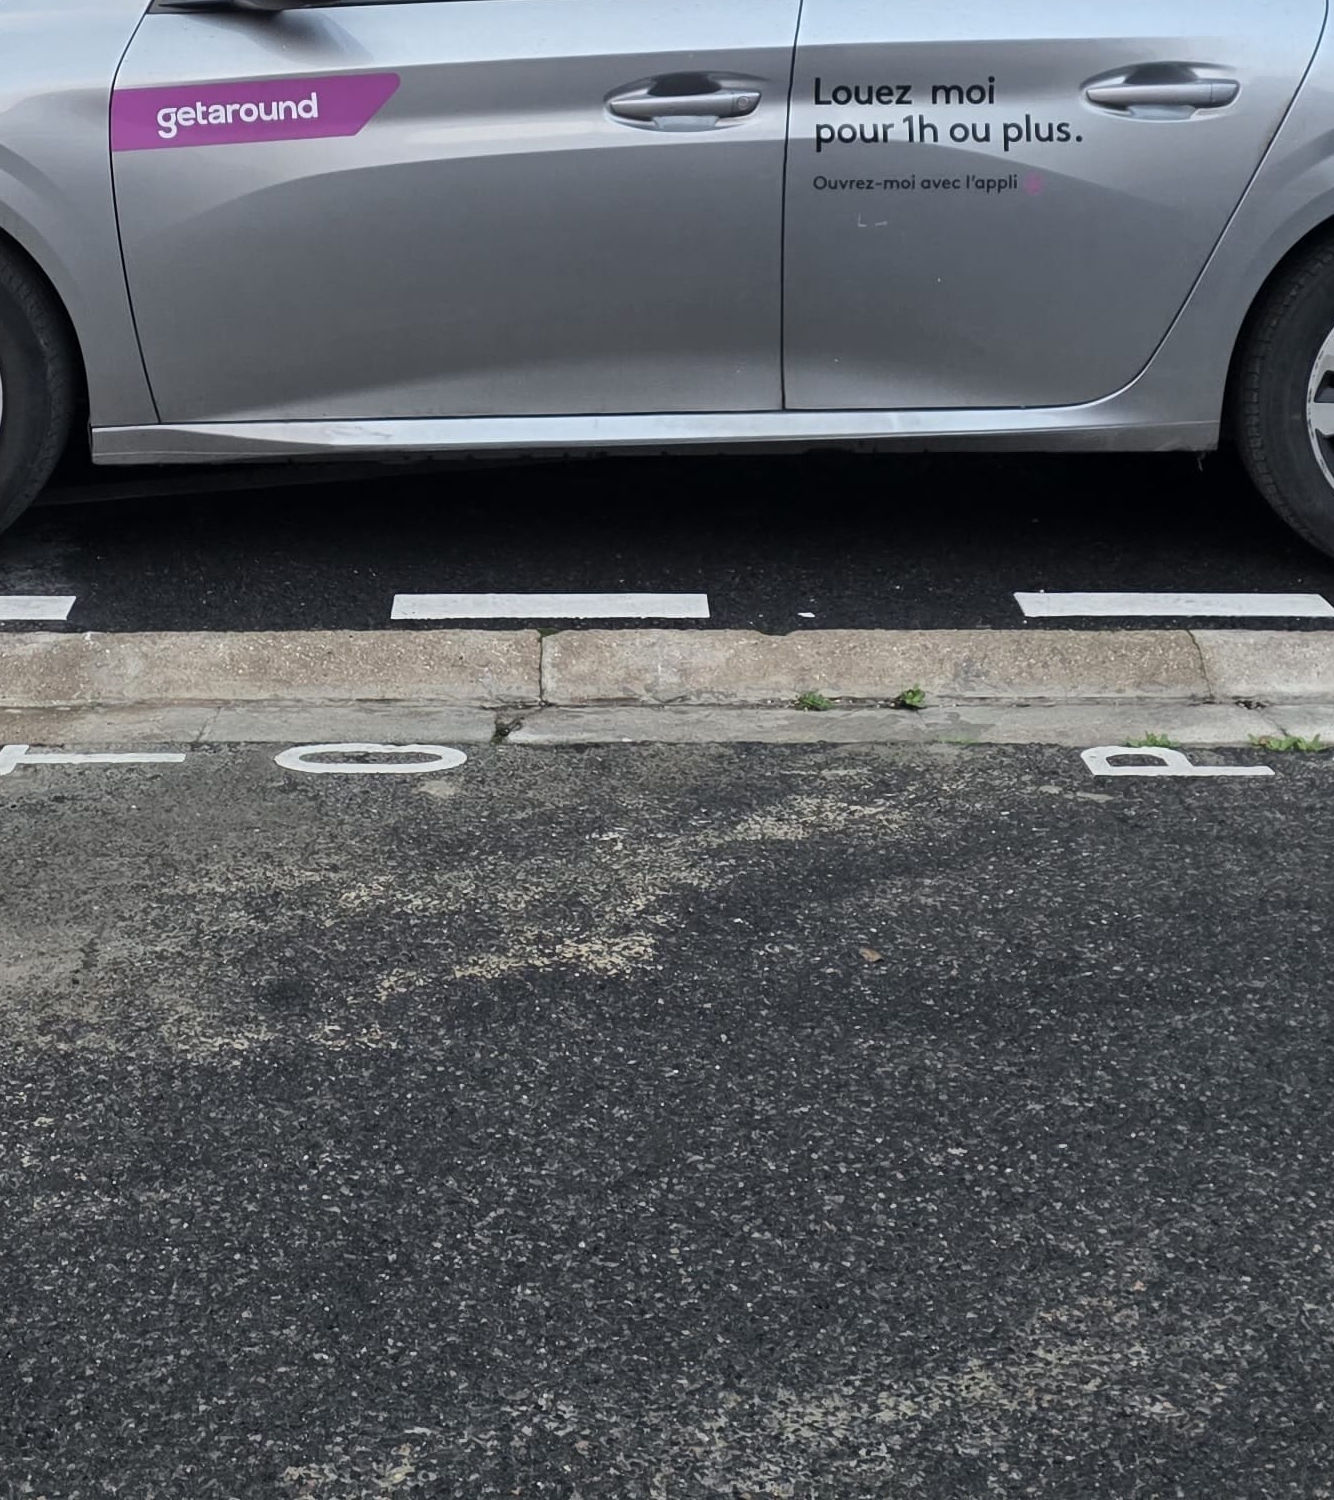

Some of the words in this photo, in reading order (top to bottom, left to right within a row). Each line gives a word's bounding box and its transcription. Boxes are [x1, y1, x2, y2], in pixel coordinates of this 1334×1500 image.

[813, 77, 912, 105] Louez
[931, 76, 995, 105] moi
[156, 92, 319, 138] getaround
[815, 122, 895, 152] pour
[902, 114, 939, 143] 1h
[948, 122, 991, 143] ou
[1003, 114, 1083, 152] plus.
[813, 174, 916, 191] Ouvrez-moi
[921, 178, 961, 191] avec
[966, 174, 1018, 194] l'appli
